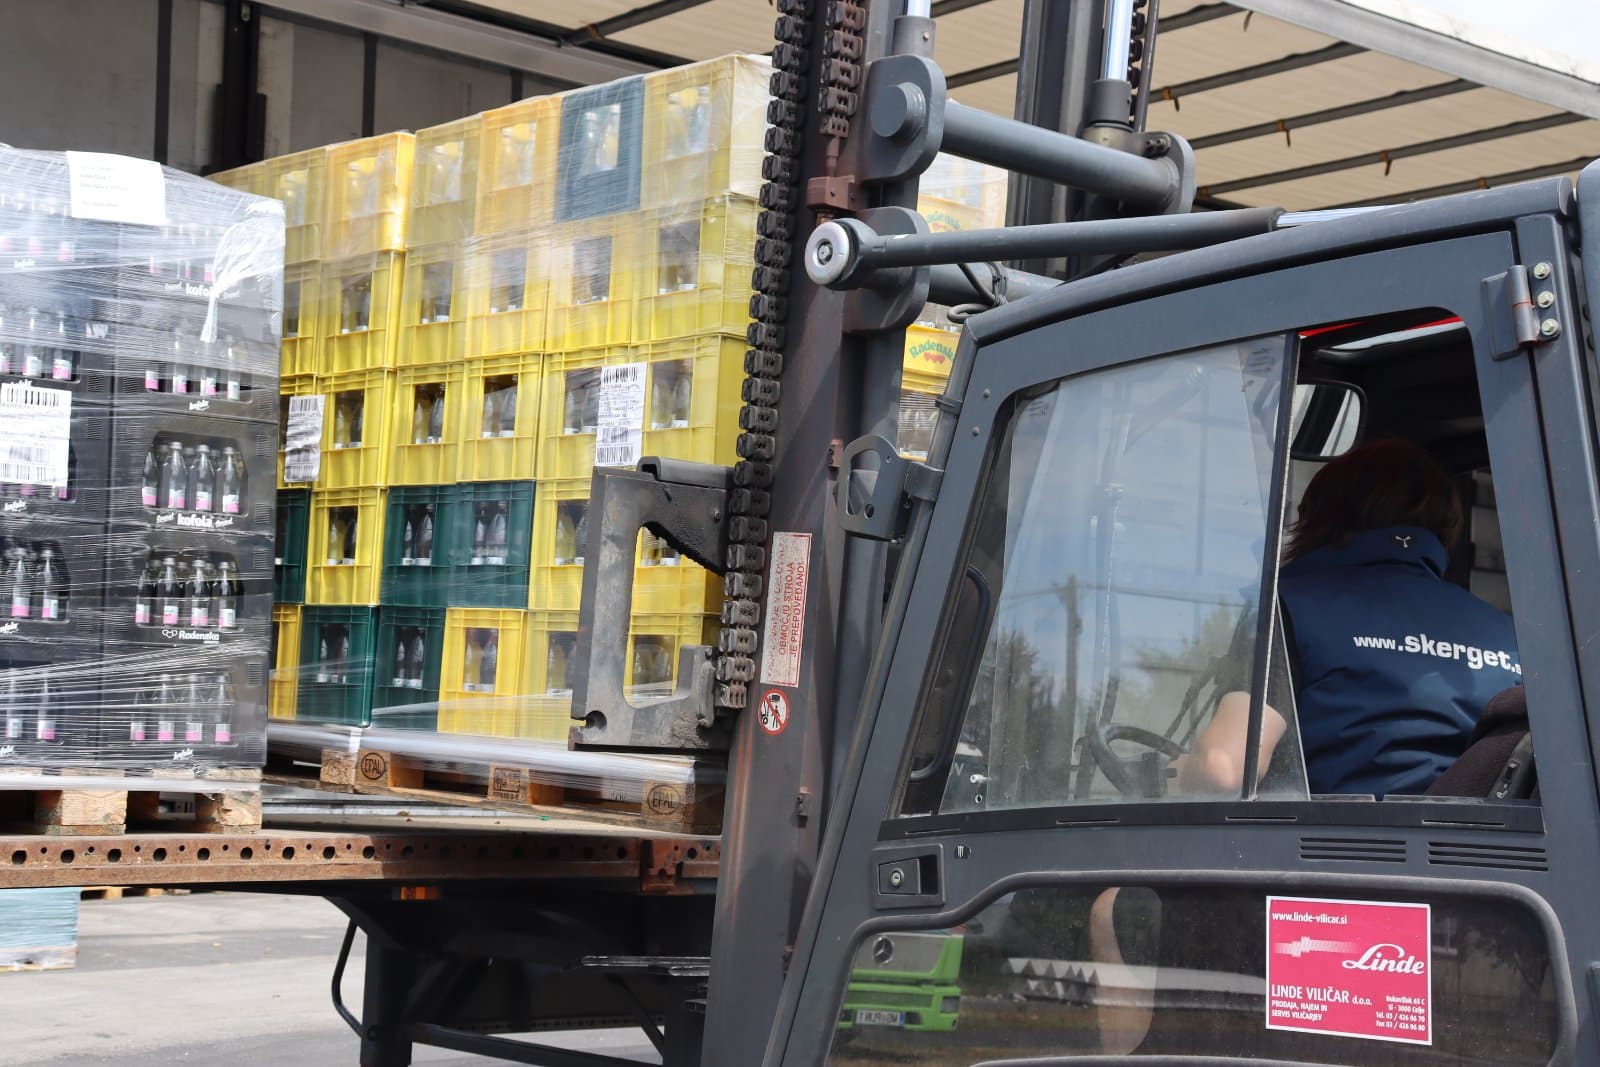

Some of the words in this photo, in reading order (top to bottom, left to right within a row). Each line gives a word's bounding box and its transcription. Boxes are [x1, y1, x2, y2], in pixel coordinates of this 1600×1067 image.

[177, 513, 213, 527] kofola
[784, 562, 795, 602] STROJA
[179, 630, 220, 641] Radenska
[789, 645, 798, 657] JE
[364, 758, 382, 774] EPAL
[652, 791, 676, 808] EPAL
[1272, 911, 1348, 925] www.linde-vilicar.si
[1342, 943, 1425, 975] Linde
[1271, 984, 1303, 999] LINDE
[1306, 986, 1350, 1004] VILIČAR
[1352, 994, 1373, 1005] d.o.o.
[1271, 1010, 1290, 1018] SERVIS
[1300, 1002, 1320, 1012] NAJEM
[1320, 1004, 1328, 1012] IN
